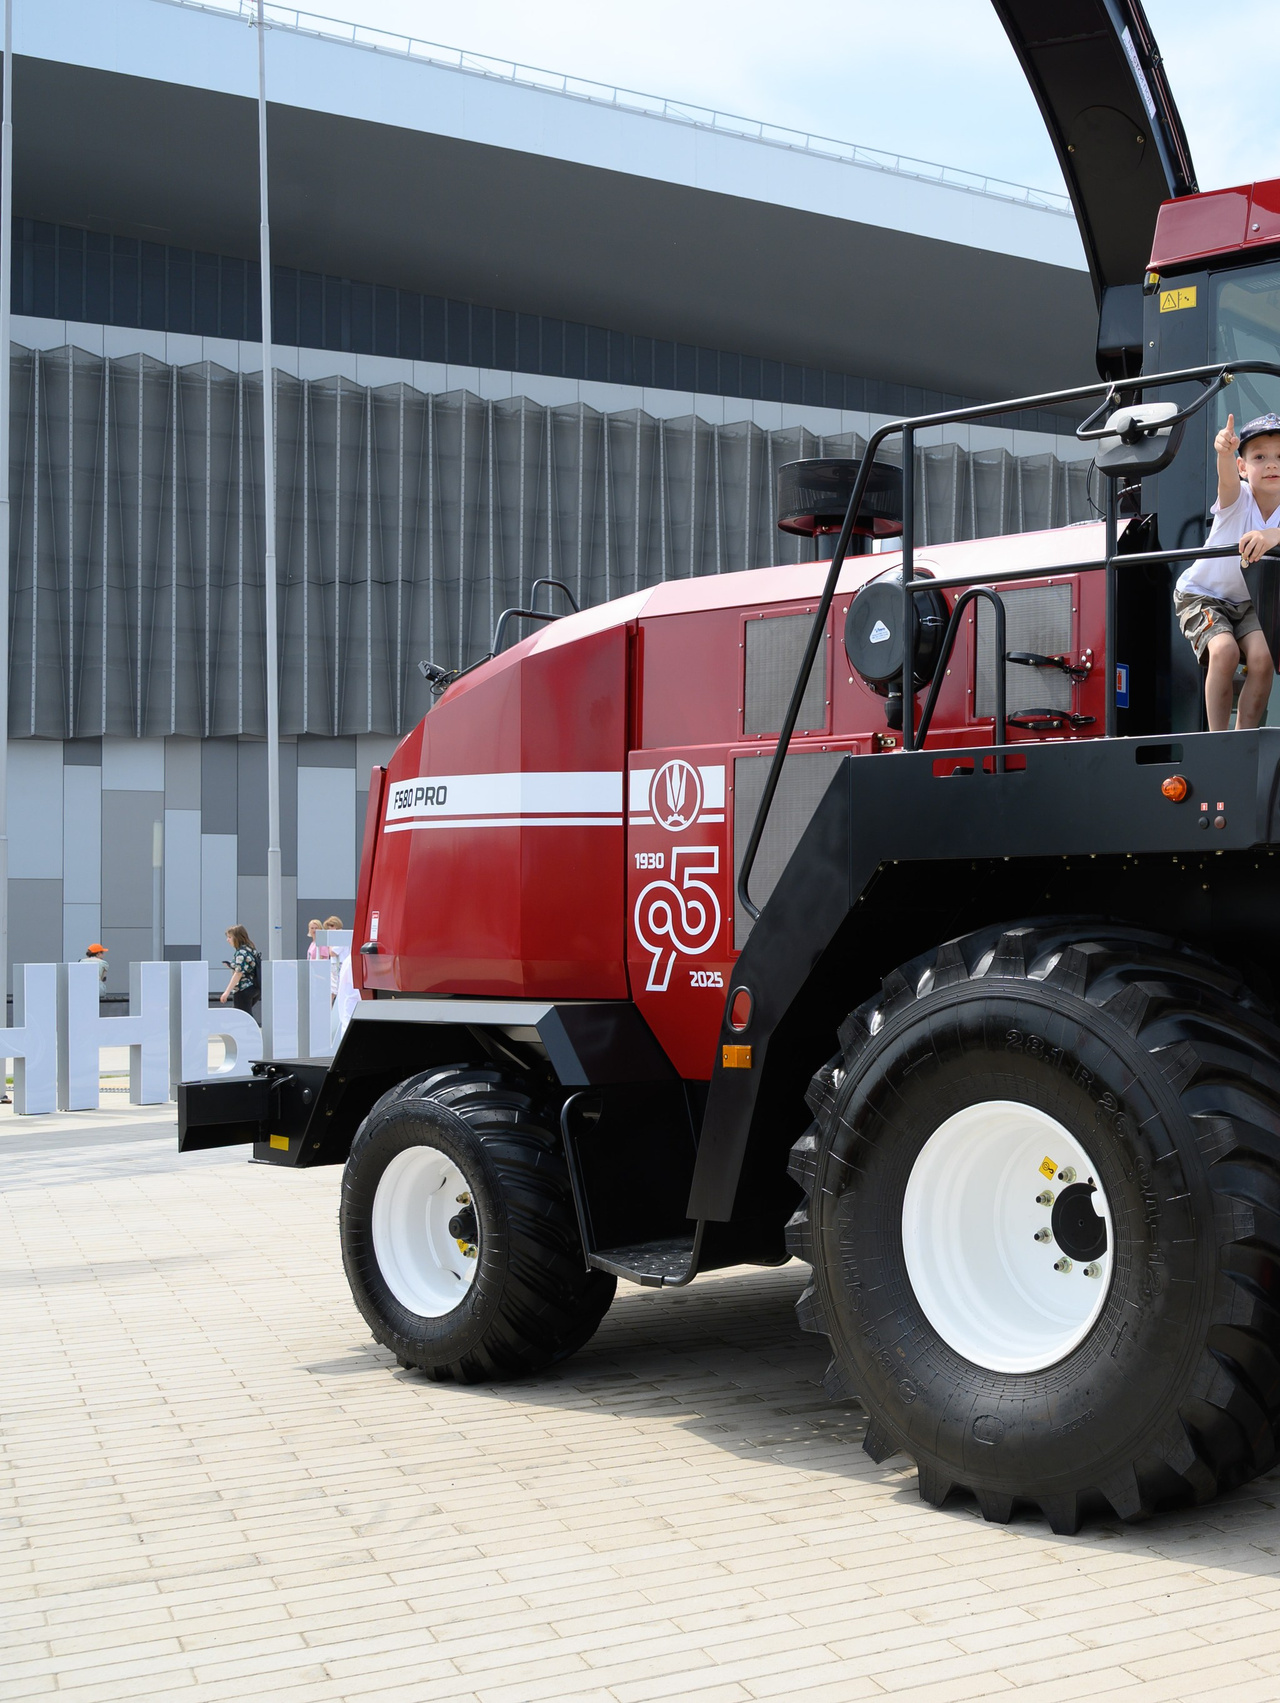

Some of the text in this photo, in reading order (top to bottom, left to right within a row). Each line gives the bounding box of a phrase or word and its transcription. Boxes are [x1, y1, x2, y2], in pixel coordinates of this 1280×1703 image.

[393, 785, 448, 810] F580 PRO
[634, 852, 665, 869] 1930
[634, 846, 721, 992] 95
[689, 970, 724, 988] 2025
